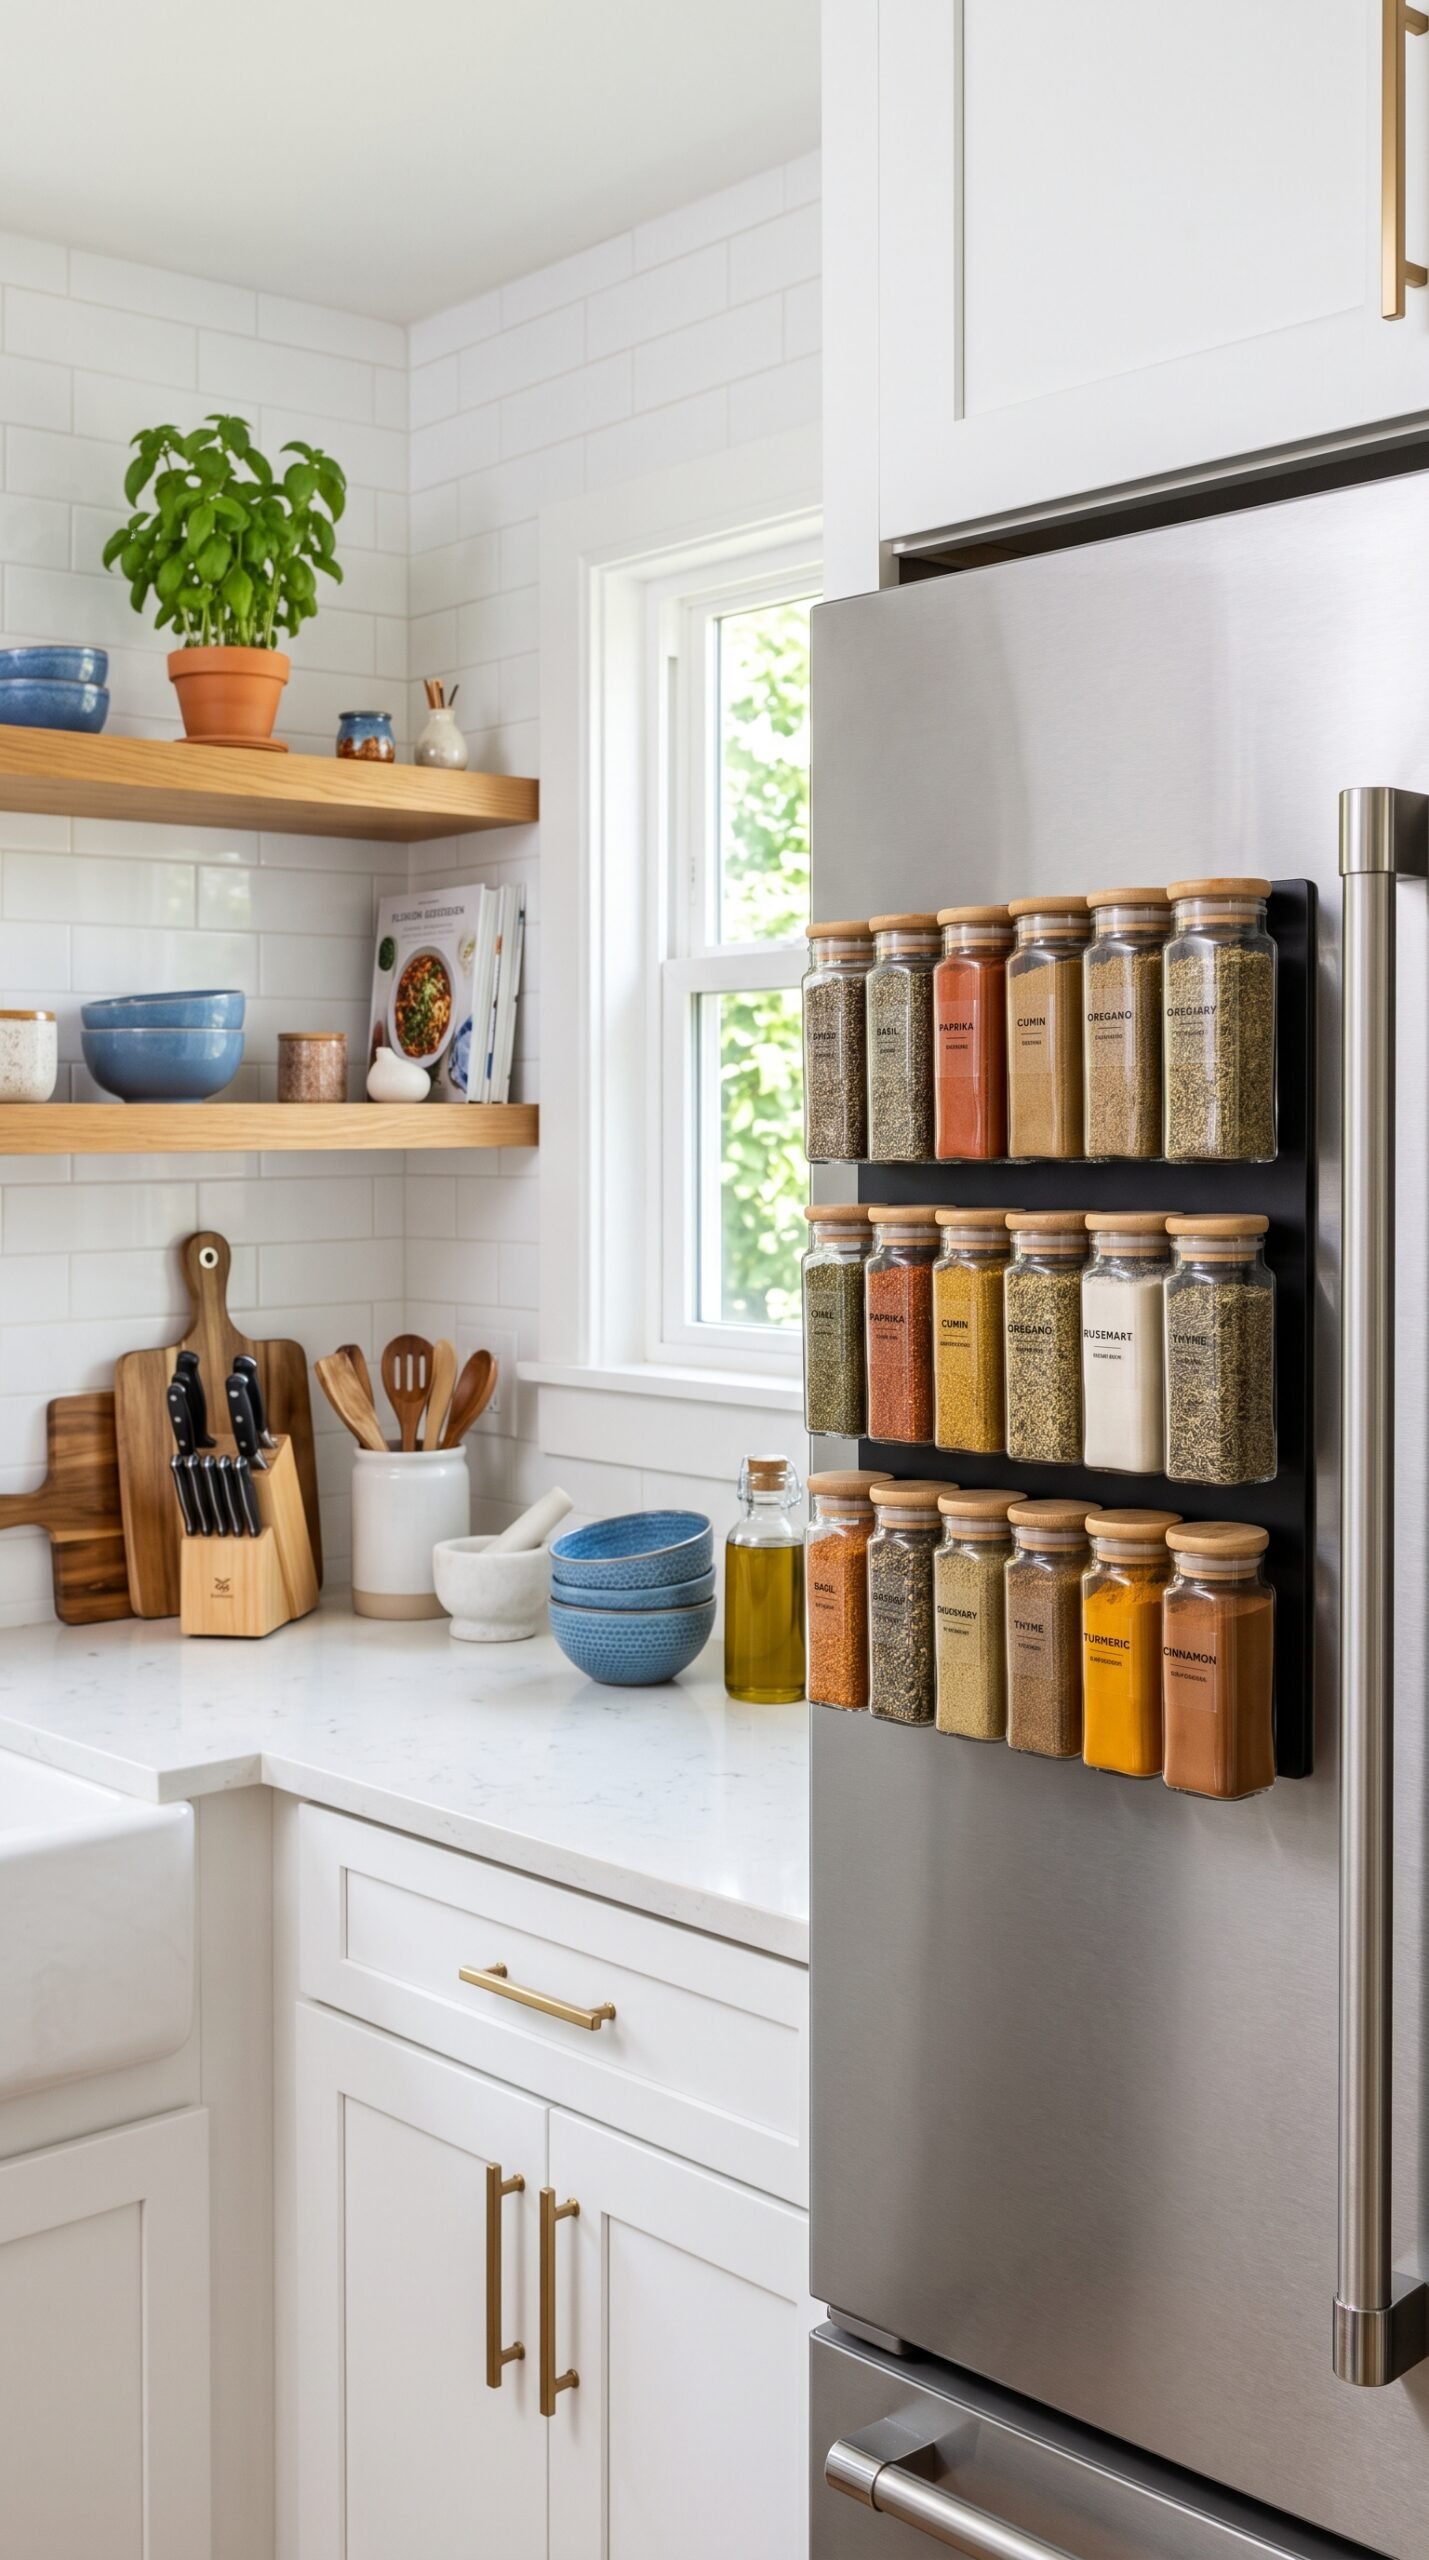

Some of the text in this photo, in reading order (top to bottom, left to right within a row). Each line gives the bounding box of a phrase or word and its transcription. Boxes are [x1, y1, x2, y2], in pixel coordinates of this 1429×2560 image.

[1087, 1010, 1132, 1022] OREGANO
[939, 1022, 974, 1031] PAPRIKA
[1017, 1017, 1046, 1027] CUMIN
[869, 1312, 905, 1324] PAPRIKA
[941, 1319, 968, 1329] CUMIN
[1007, 1324, 1052, 1335] OREGANO
[1083, 1633, 1130, 1650] TURMERIC
[1163, 1647, 1217, 1665] CINNAMON
